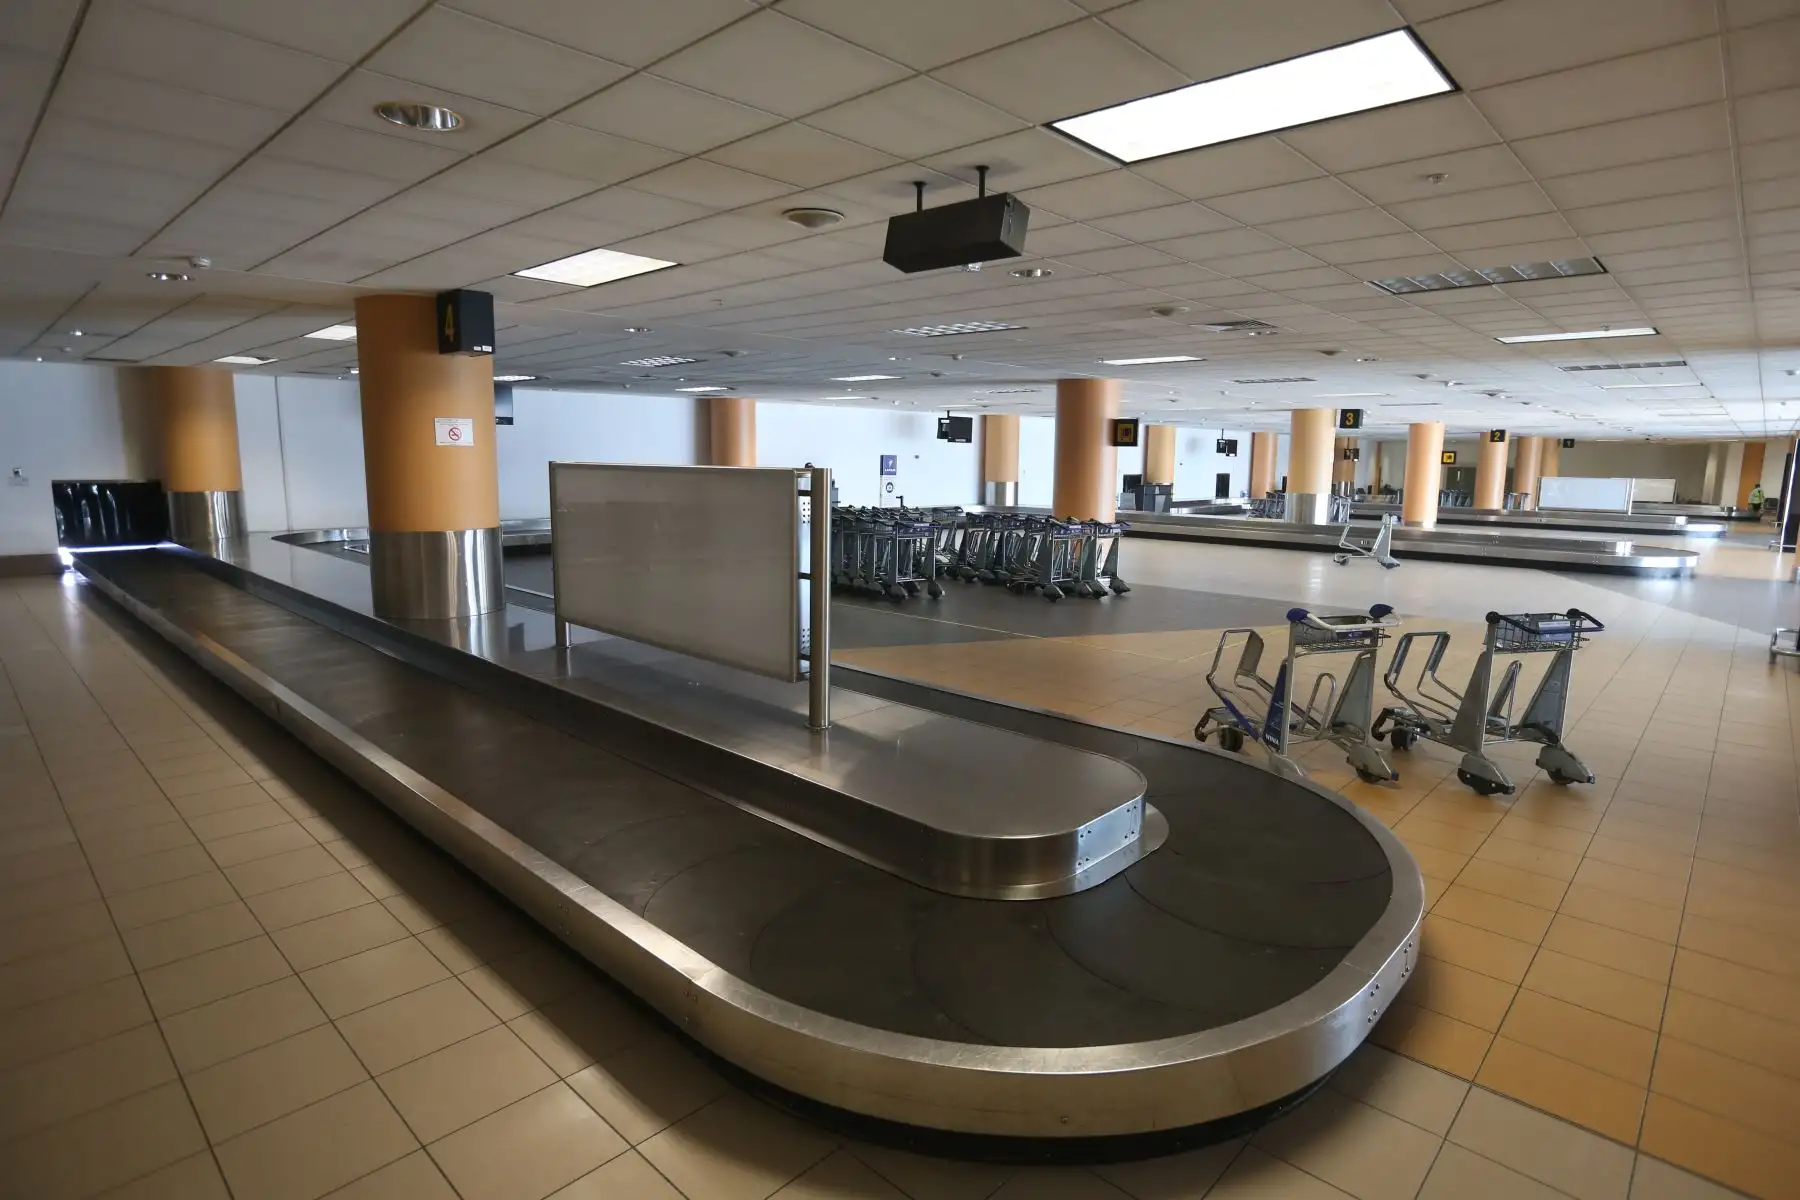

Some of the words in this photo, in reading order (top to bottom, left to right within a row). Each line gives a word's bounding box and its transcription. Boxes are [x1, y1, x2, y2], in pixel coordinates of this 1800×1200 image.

[444, 303, 455, 343] 4
[1345, 412, 1354, 425] 3
[1494, 431, 1501, 441] 2
